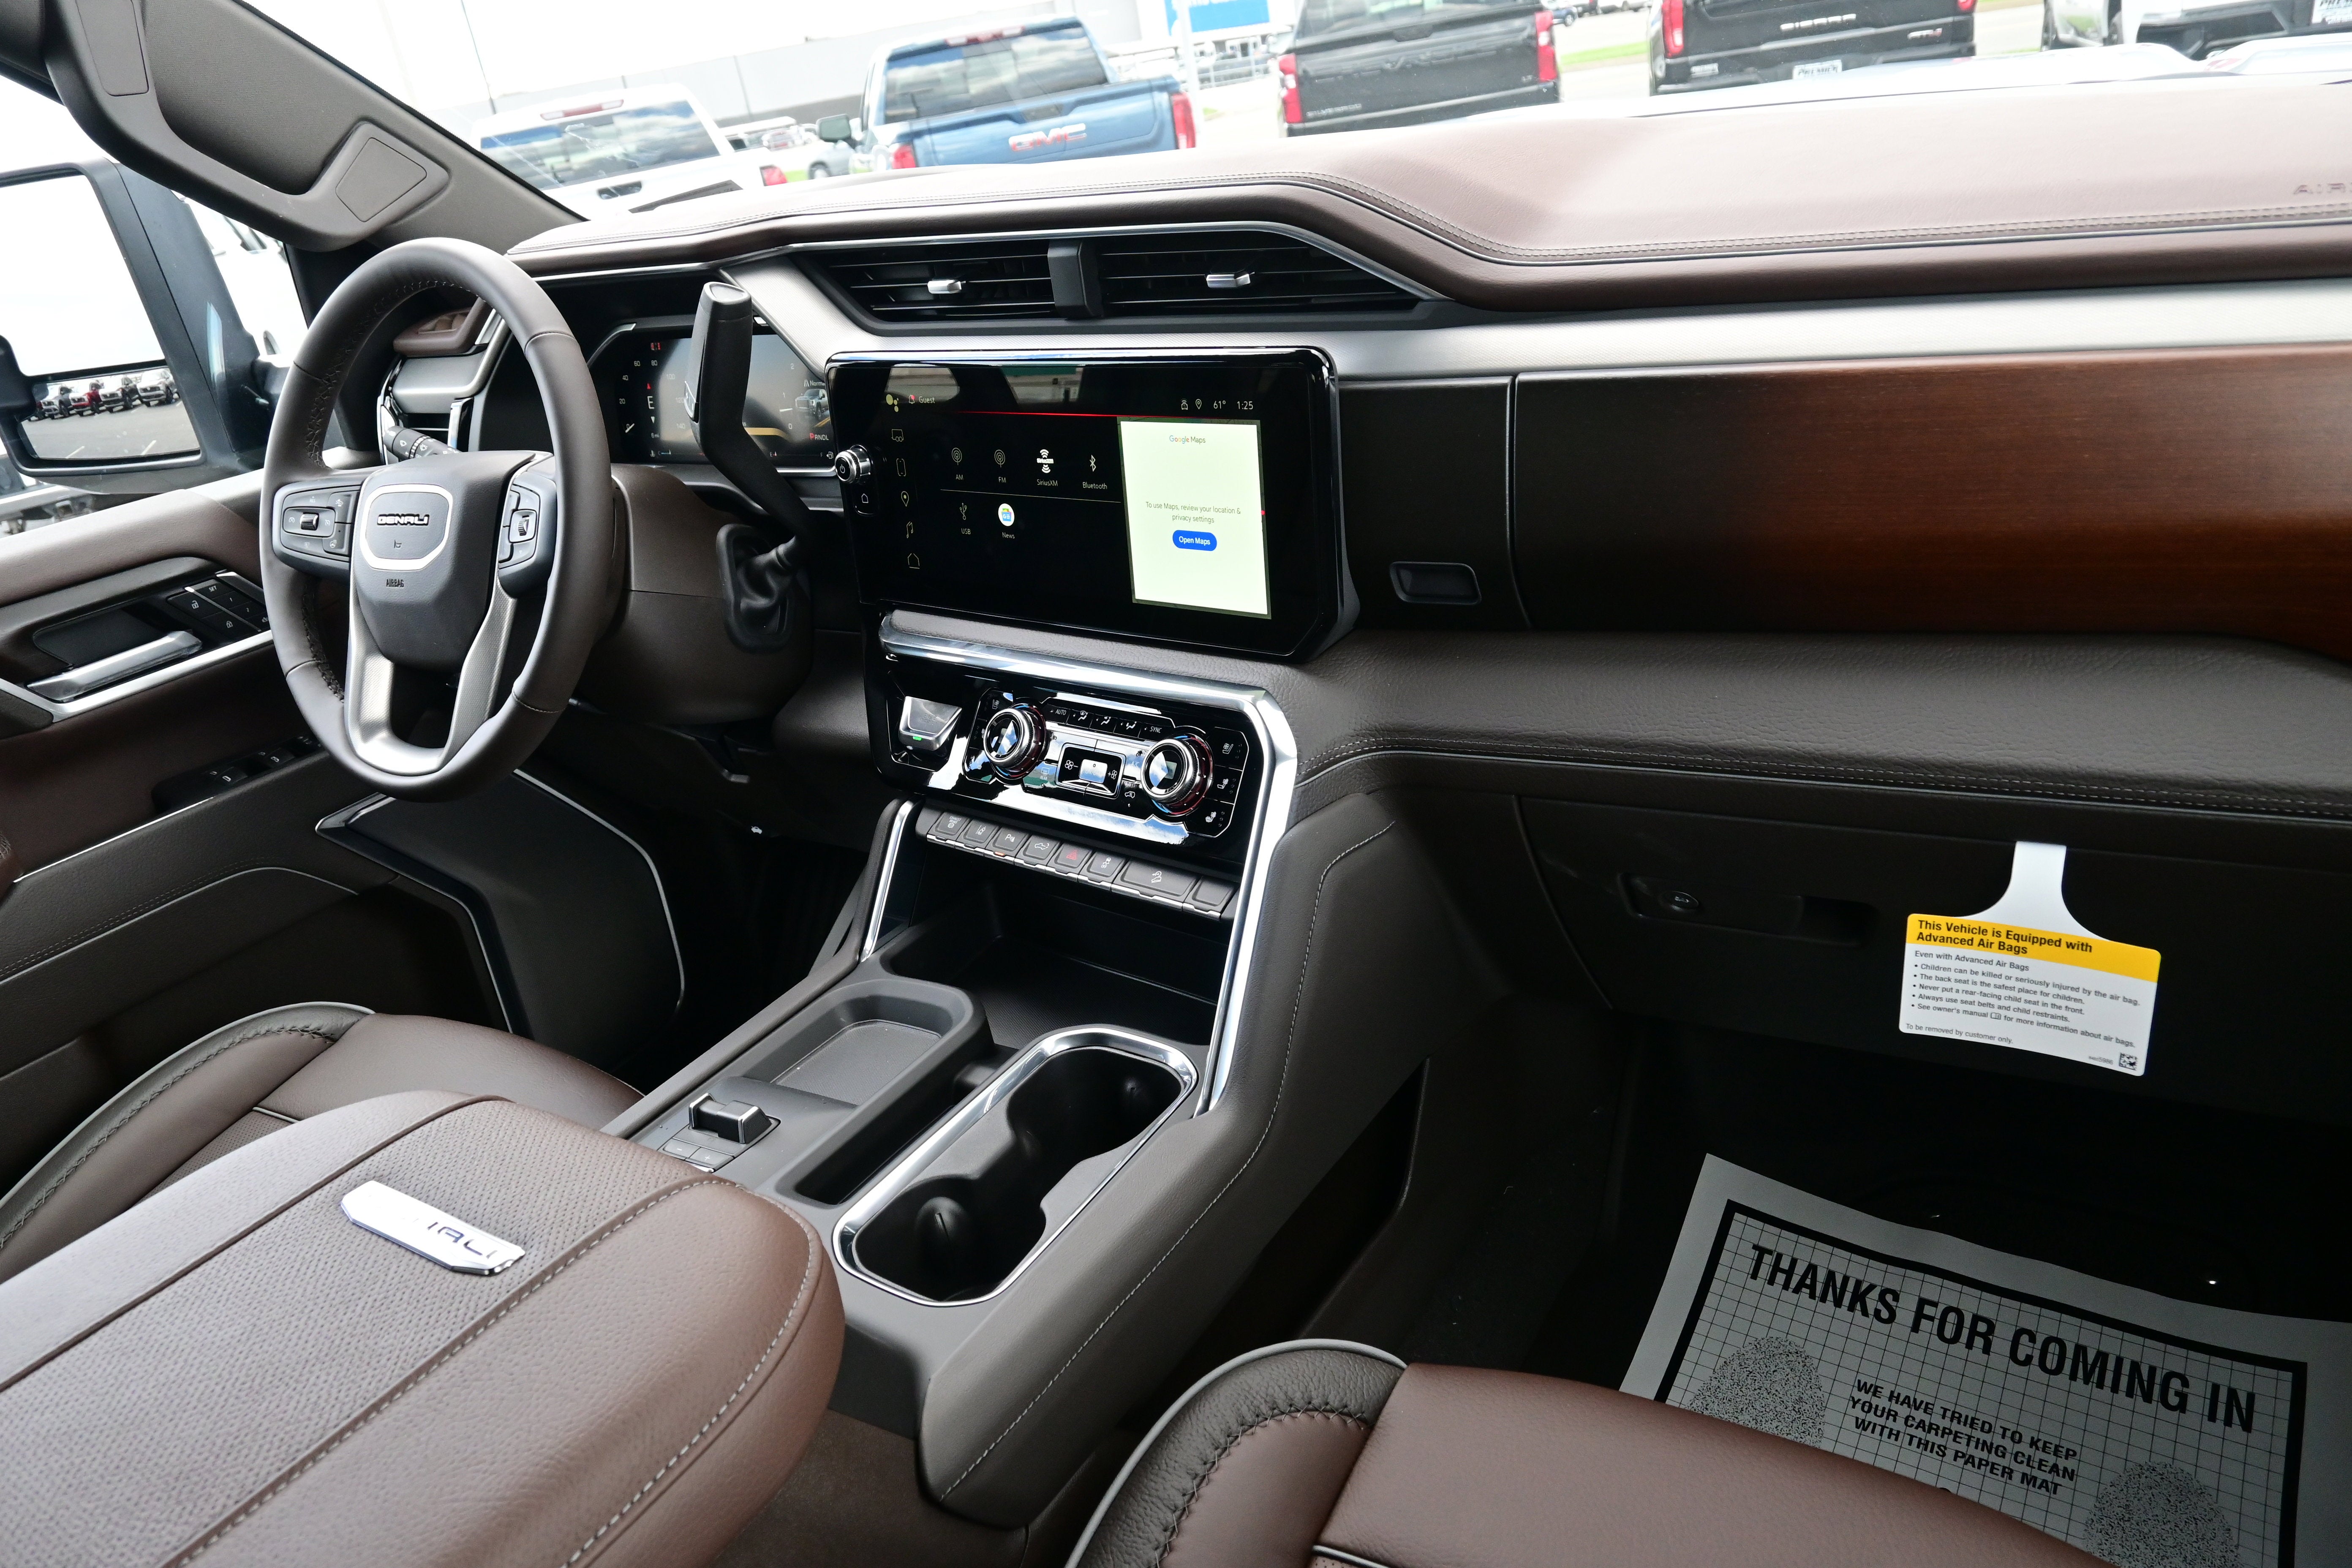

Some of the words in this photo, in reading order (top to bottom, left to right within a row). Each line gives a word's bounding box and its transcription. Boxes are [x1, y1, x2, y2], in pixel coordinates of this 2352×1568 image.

[1008, 123, 1087, 151] GMC
[2293, 182, 2352, 195] AIR
[647, 396, 655, 409] E
[1237, 401, 1253, 410] 1:25
[1169, 435, 1190, 444] Google
[1190, 436, 1206, 444] Maps
[1082, 482, 1107, 490] Bluetooth
[1164, 503, 1179, 511] Maps,
[377, 514, 430, 526] DENALI
[1172, 514, 1191, 523] privacy
[1193, 515, 1214, 524] settings
[1179, 536, 1194, 544] Open
[1195, 537, 1211, 546] Maps
[386, 579, 404, 588] AIRBAG
[1916, 932, 1974, 946] Advanced
[1977, 939, 1995, 948] Air
[1998, 941, 2028, 955] Bags
[1918, 920, 1942, 931] This
[1946, 923, 1988, 936] Vehicle
[1992, 928, 2001, 938] is
[2006, 930, 2062, 947] Equipped
[2066, 941, 2092, 953] with
[1955, 955, 1993, 965] Advanced
[2010, 962, 2029, 972] Bags
[1921, 964, 1951, 972] Children
[1982, 971, 2002, 979] killed
[2015, 977, 2050, 988] seriously
[2053, 982, 2080, 993] injured
[2082, 988, 2092, 996] by
[2094, 990, 2107, 999] the
[2123, 996, 2140, 1006] bag.
[1993, 983, 2016, 992] safest
[2018, 987, 2038, 995] place
[2053, 994, 2085, 1004] children.
[1918, 994, 1943, 1002] Always
[1978, 1001, 1995, 1009] belts
[2013, 1007, 2031, 1015] child
[2033, 1010, 2070, 1022] restraints.
[1962, 989, 2002, 1001] rear-facing
[2065, 1005, 2085, 1015] front.
[1925, 1027, 1953, 1035] removed
[1965, 1032, 1996, 1041] customer
[1933, 1006, 1960, 1014] owner's
[1963, 1010, 1988, 1018] manual
[2016, 1018, 2034, 1026] more
[2036, 1021, 2078, 1034] information
[2080, 1030, 2101, 1040] about
[2115, 1037, 2135, 1048] bags.
[1750, 1244, 1900, 1325] THANKS
[1911, 1297, 1996, 1356] FOR
[2009, 1327, 2190, 1414] COMING
[2207, 1383, 2256, 1433] IN
[1857, 1380, 1884, 1399] WE
[1888, 1390, 1935, 1416] HAVE
[1940, 1406, 1993, 1434] TRIED
[2000, 1425, 2023, 1444] TO
[2029, 1436, 2077, 1460] KEEP
[1851, 1396, 1898, 1423] YOUR
[1904, 1415, 2007, 1459] CARPETING
[2014, 1451, 2075, 1482] CLEAN
[1854, 1416, 1901, 1441] WITH
[1906, 1433, 1947, 1457] THIS
[1953, 1450, 2014, 1481] PAPER
[2020, 1472, 2062, 1495] MAT
